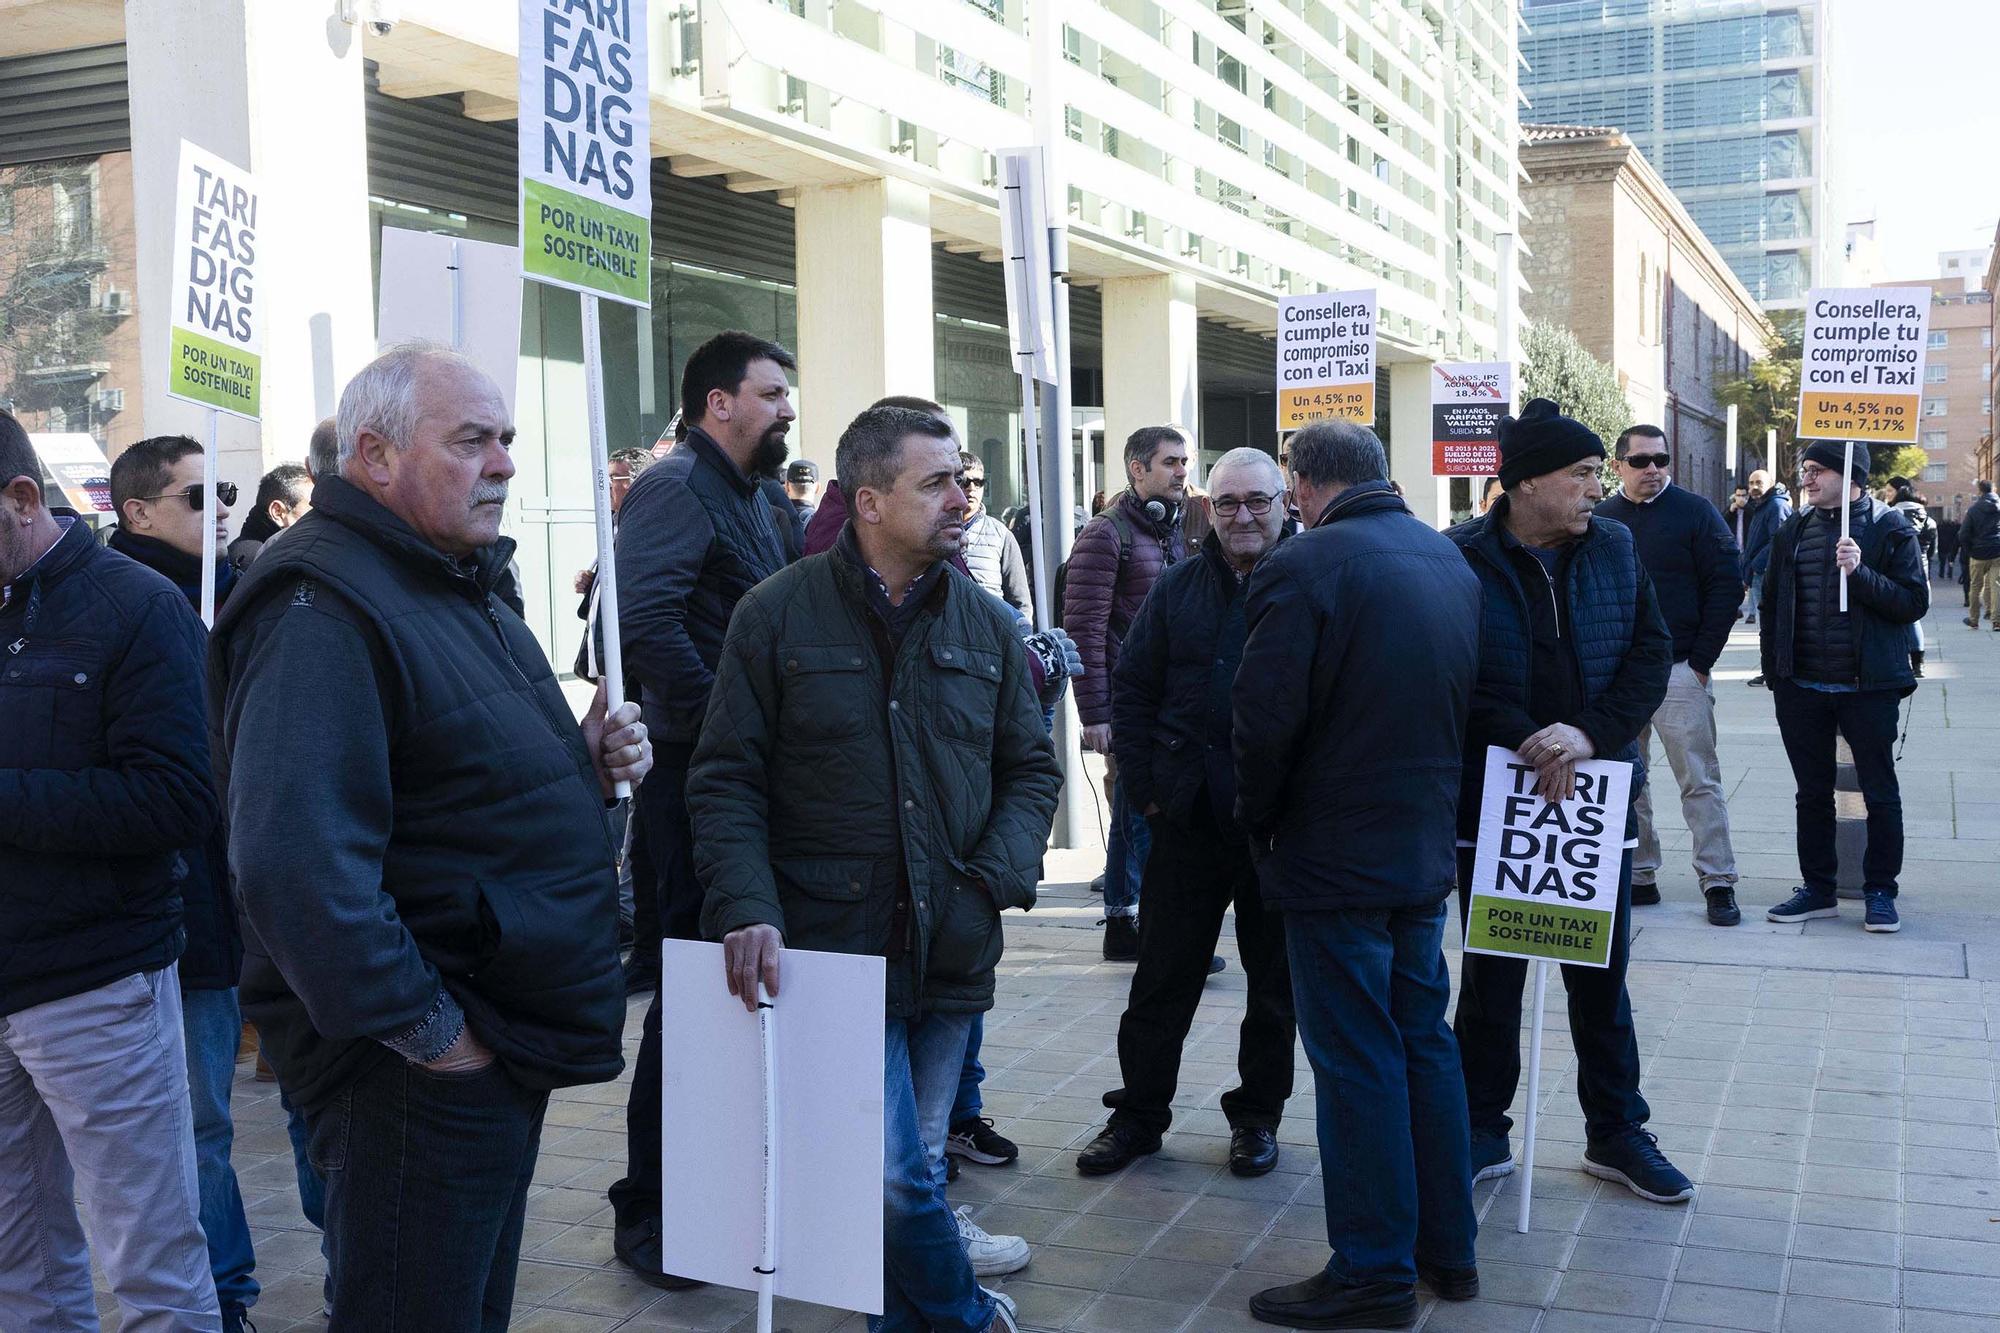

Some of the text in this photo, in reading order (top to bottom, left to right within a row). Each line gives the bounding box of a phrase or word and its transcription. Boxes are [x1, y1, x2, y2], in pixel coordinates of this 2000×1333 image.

[544, 8, 633, 94] FAS
[544, 65, 633, 147] DIG
[544, 121, 634, 200] NAS
[193, 164, 257, 230] TARI
[191, 205, 255, 266] FAS
[541, 204, 639, 253] POR UN TAXI
[543, 233, 637, 279] SOSTENIBLE
[189, 246, 254, 304] DIG
[187, 286, 251, 342] NAS
[1284, 302, 1370, 322] Consellera,
[1815, 299, 1922, 322] Consellera,
[1284, 321, 1370, 342] cumple tu
[1813, 321, 1920, 344] cumple tu
[182, 344, 254, 381] POR UN TAXI
[1284, 340, 1370, 363] compromiso
[1811, 344, 1918, 366] compromiso
[1284, 358, 1369, 381] con el Taxi
[1809, 365, 1916, 385] con el Taxi
[183, 365, 251, 400] SOSTENIBLE
[1455, 389, 1487, 398] 18,4%
[1293, 393, 1363, 407] Un 4,5% no
[1468, 407, 1490, 415] AÑOS,
[1818, 401, 1904, 416] Un 4,5% no
[1291, 406, 1364, 421] es un 717%
[1814, 418, 1905, 432] es un 7,17%
[1449, 427, 1492, 435] SUBIDA 3%
[1471, 464, 1495, 472] 19%
[1506, 762, 1609, 805] TRI
[1503, 795, 1605, 837] FAS
[1499, 828, 1601, 869] DIG
[1495, 860, 1599, 902] NAS
[1488, 908, 1598, 934] POR UN TAXI
[1488, 925, 1593, 950] SOSTENIBLE
